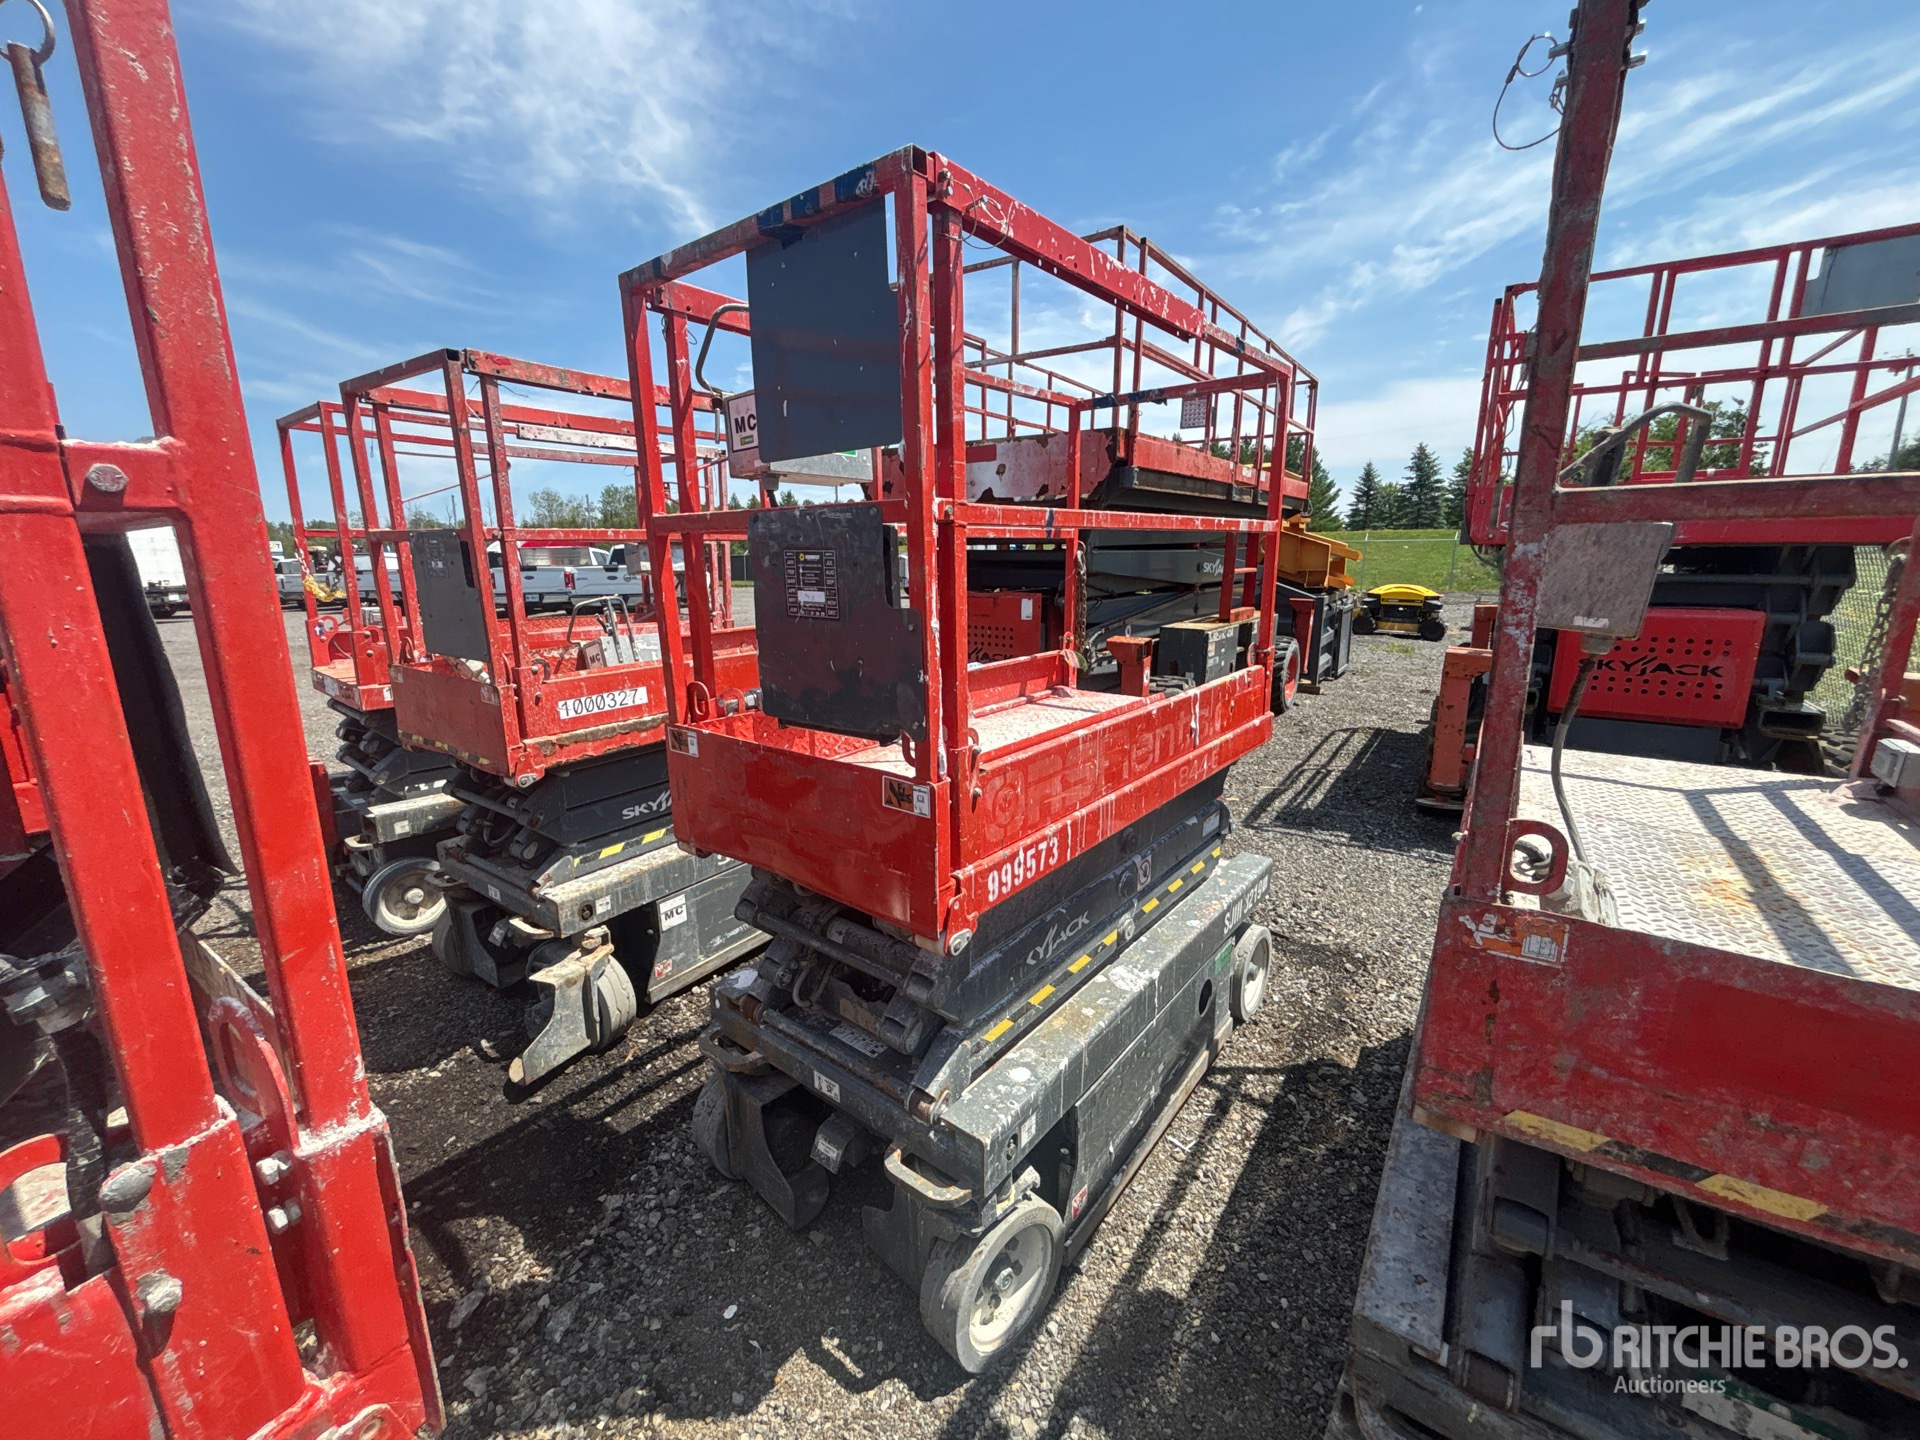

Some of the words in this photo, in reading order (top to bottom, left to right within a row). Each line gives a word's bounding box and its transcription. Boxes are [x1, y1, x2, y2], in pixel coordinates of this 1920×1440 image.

[734, 413, 757, 434] MC
[589, 653, 600, 664] MC
[560, 688, 638, 717] 1000327
[987, 836, 1059, 903] 999573
[664, 906, 684, 921] MC
